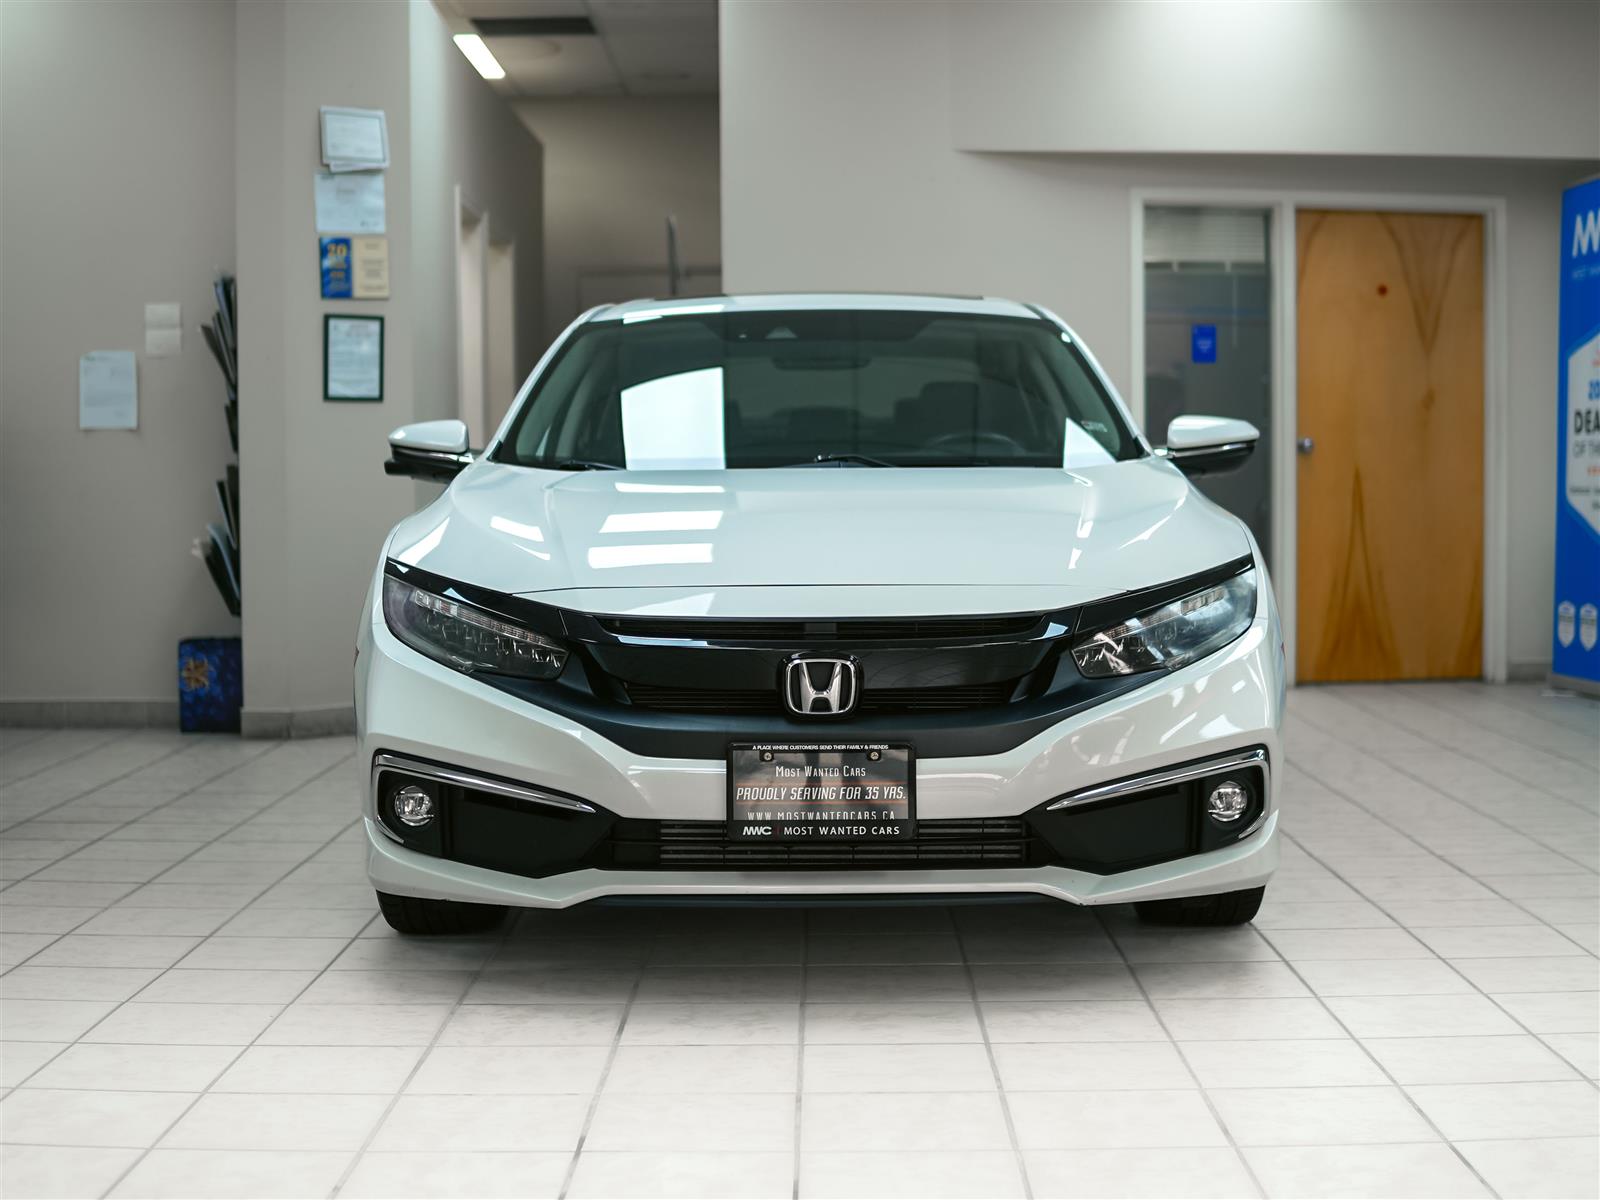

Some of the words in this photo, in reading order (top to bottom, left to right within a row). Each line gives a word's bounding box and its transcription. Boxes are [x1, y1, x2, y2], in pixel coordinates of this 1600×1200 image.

[736, 787, 787, 800] PROUDLY
[790, 787, 836, 800] SERVING
[839, 786, 861, 800] FOR
[864, 786, 879, 800] 35
[883, 786, 906, 800] YRS.
[783, 826, 814, 836] MOST
[819, 826, 867, 836] WANTED
[871, 826, 900, 836] CARS
